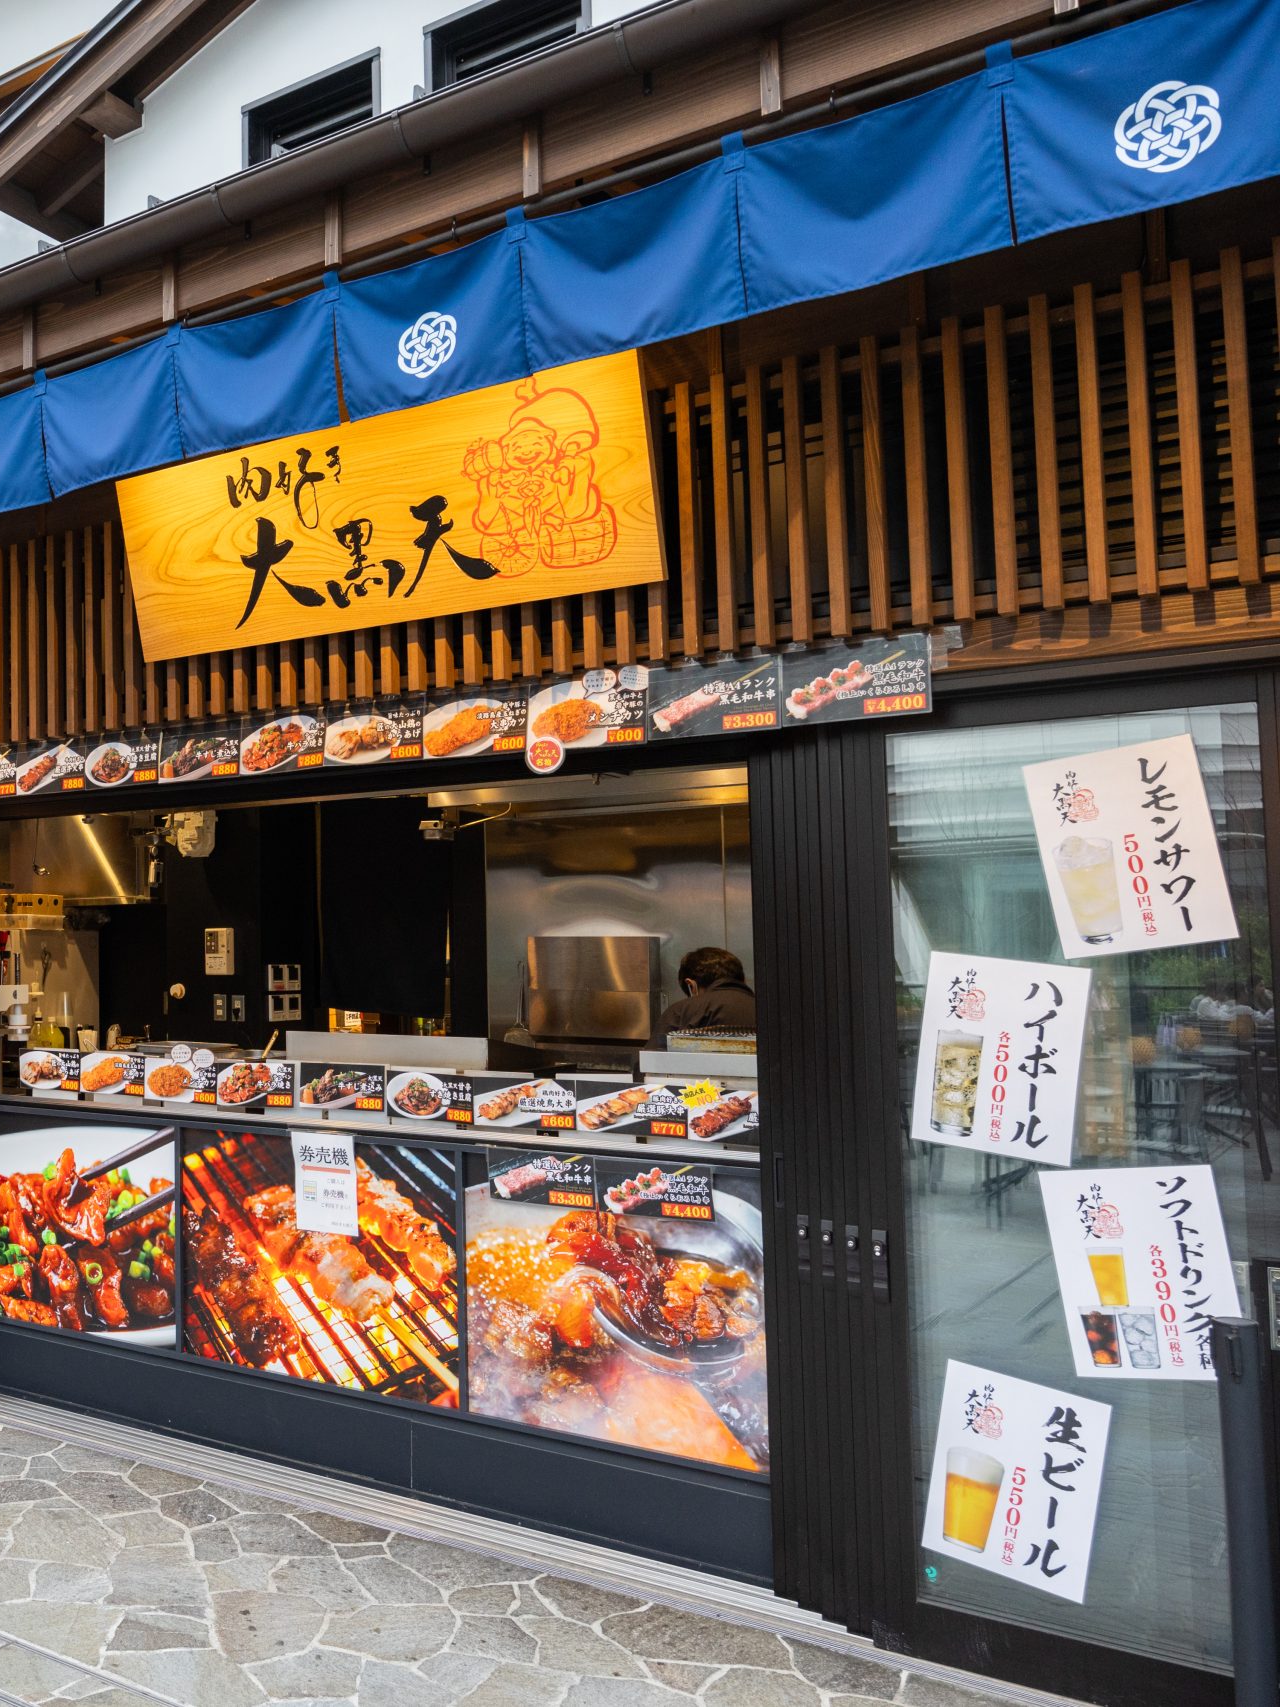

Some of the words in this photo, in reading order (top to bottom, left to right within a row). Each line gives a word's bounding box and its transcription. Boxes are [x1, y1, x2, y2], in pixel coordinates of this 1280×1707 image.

[226, 445, 341, 529] 肉好き
[235, 495, 500, 630] 大黒天
[872, 668, 926, 686] 黒毛和牛
[719, 690, 776, 705] 黒毛和牛串
[867, 695, 924, 712] ¥4,400
[387, 710, 420, 719] 旨味たっぷり
[588, 710, 643, 723] メンチカツ
[724, 712, 775, 728] ¥3,300
[609, 730, 642, 742] ¥600
[287, 738, 322, 750] 牛バラ焼き
[495, 738, 524, 750] ¥600
[195, 747, 238, 760] 牛すじ煮込み
[392, 746, 420, 758] ¥600
[300, 754, 322, 766] ¥880
[214, 763, 238, 775] ¥880
[134, 771, 156, 782] ¥880
[64, 778, 84, 790] ¥880
[1137, 757, 1196, 931] レモンサワー
[1010, 980, 1064, 1149] ハイボール
[337, 1082, 383, 1092] 牛すじ煮込み
[269, 1095, 291, 1106] ¥880
[357, 1098, 382, 1110] ¥880
[448, 1109, 471, 1121] ¥880
[543, 1116, 572, 1128] ¥660
[653, 1123, 684, 1136] ¥770
[299, 1145, 350, 1166] 券売機
[545, 1171, 592, 1184] 黒毛和牛串
[667, 1183, 709, 1194] 黒毛和牛
[551, 1192, 591, 1206] ¥3,300
[665, 1204, 709, 1218] ¥4,400
[1023, 1405, 1088, 1578] 生ビール
